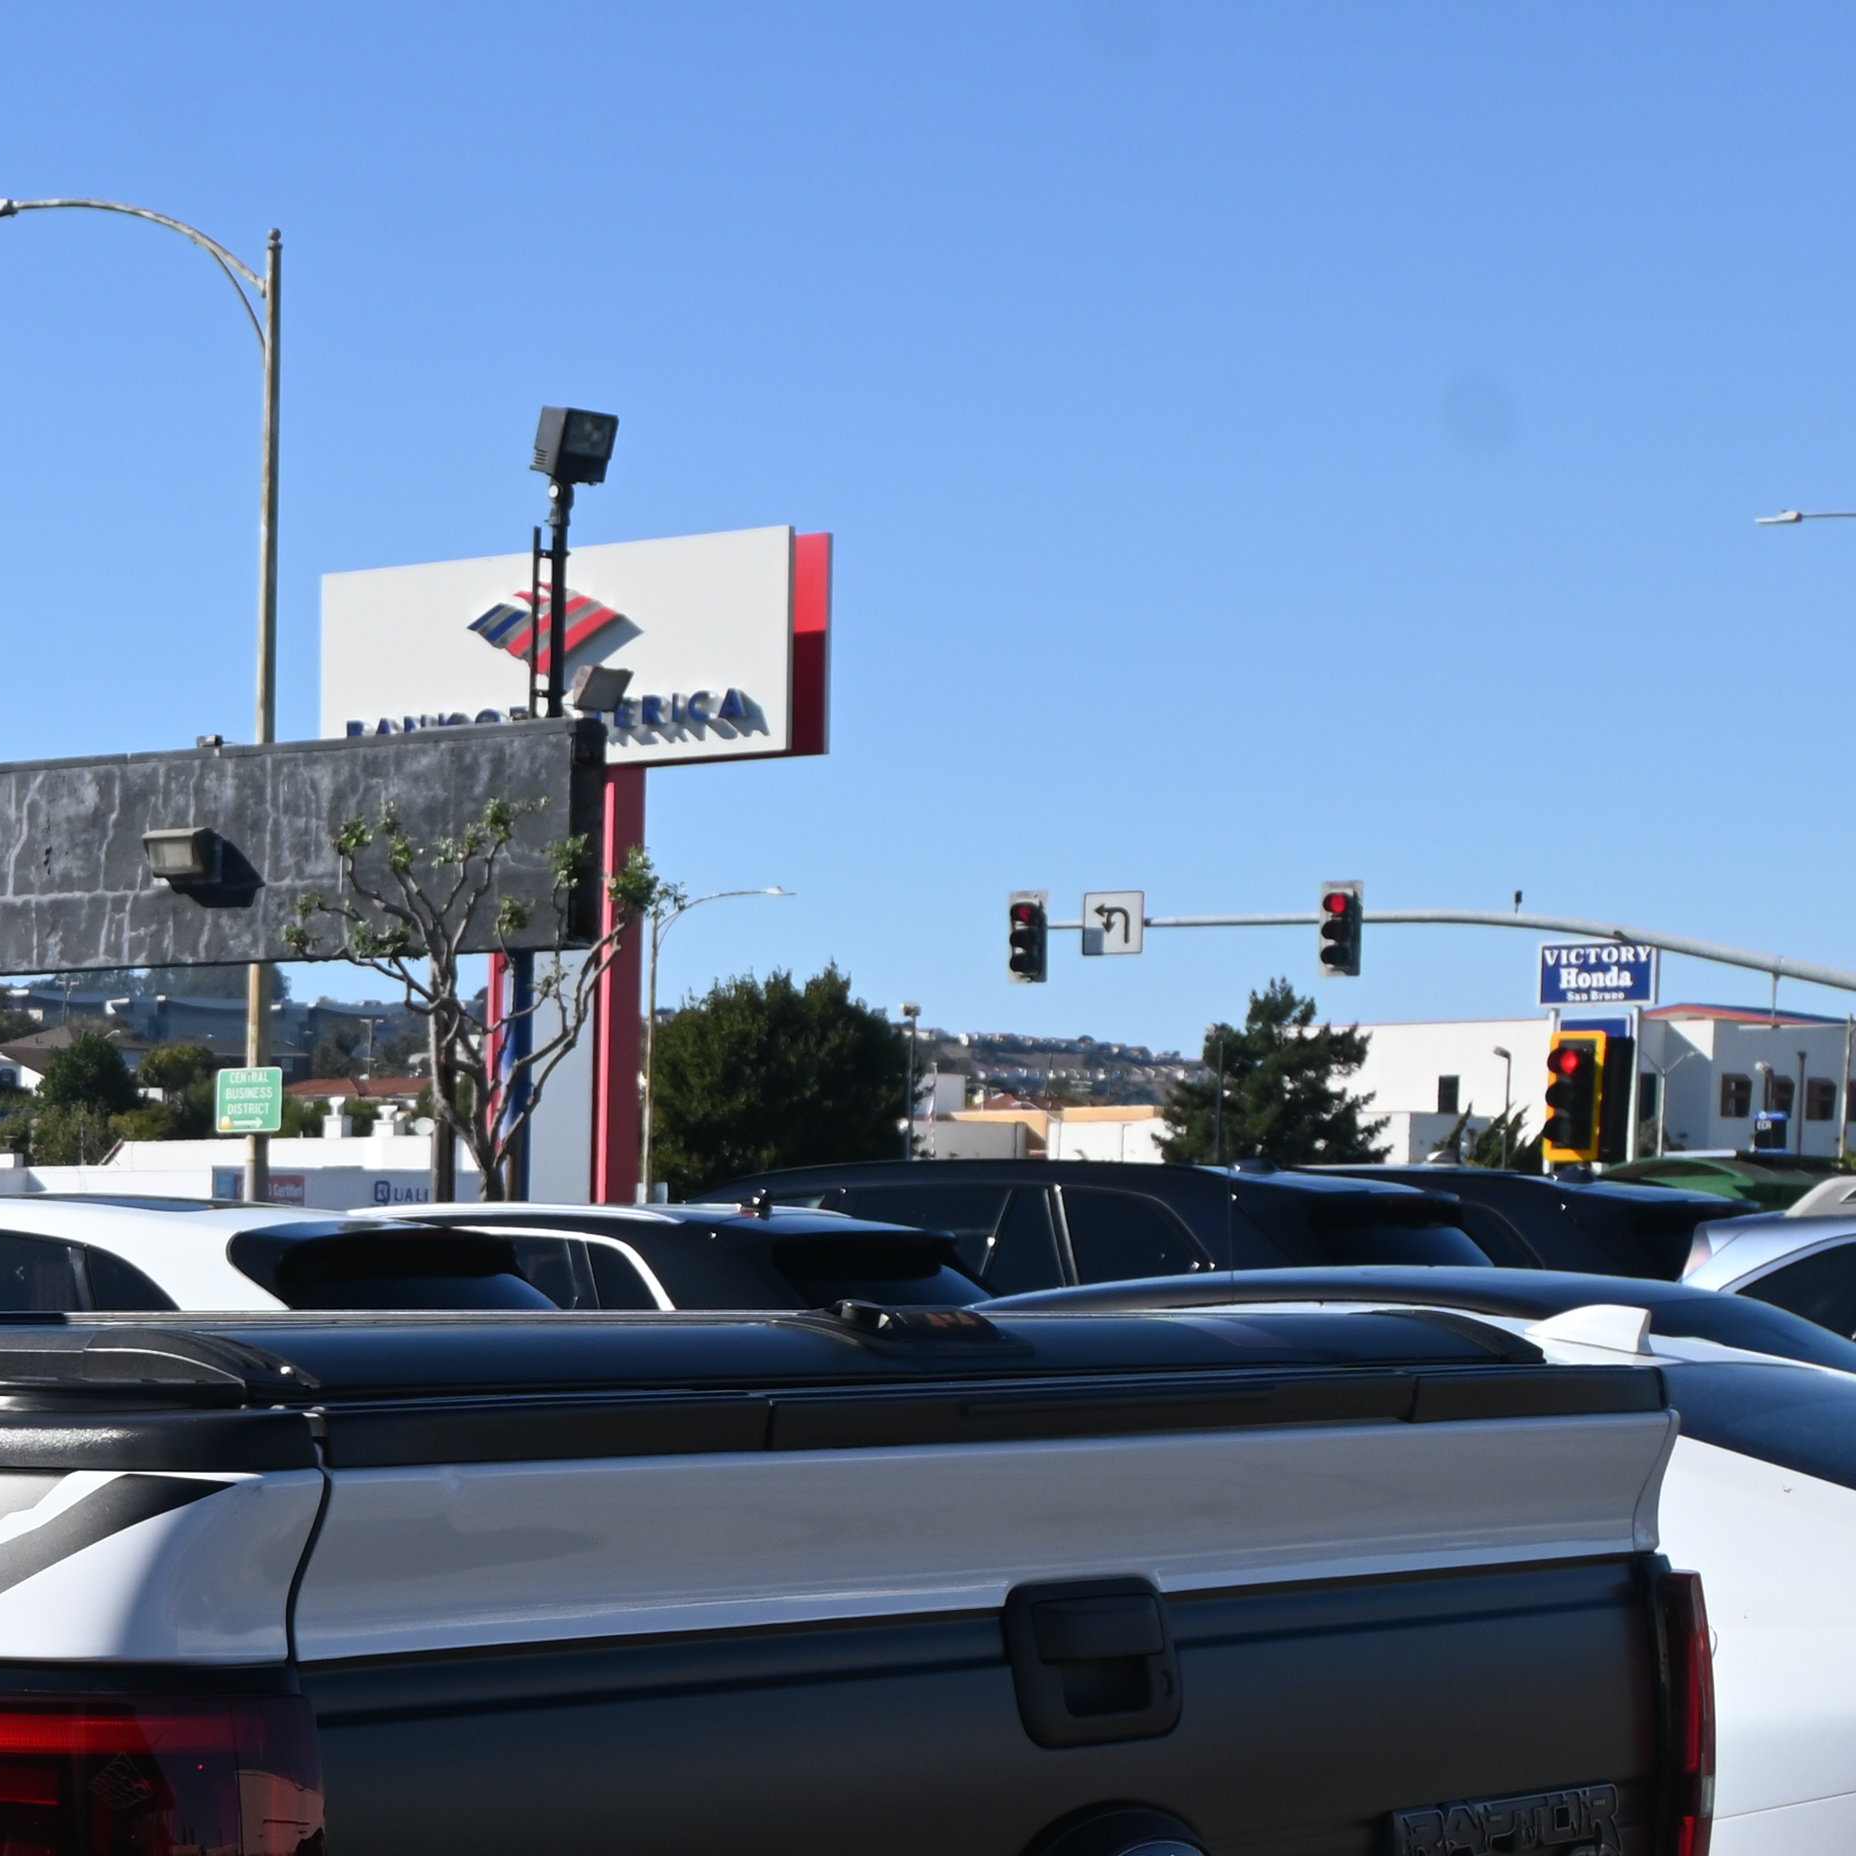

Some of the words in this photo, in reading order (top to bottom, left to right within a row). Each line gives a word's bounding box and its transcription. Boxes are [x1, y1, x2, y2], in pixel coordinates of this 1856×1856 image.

[1544, 945, 1652, 966] VICTORY
[1559, 966, 1633, 989] Honda
[1566, 991, 1588, 1001] San
[1590, 990, 1624, 1001] Bruno
[230, 1071, 269, 1084] CENTRAL
[225, 1086, 273, 1100] BUSINESS
[227, 1102, 270, 1115] DISTRICT
